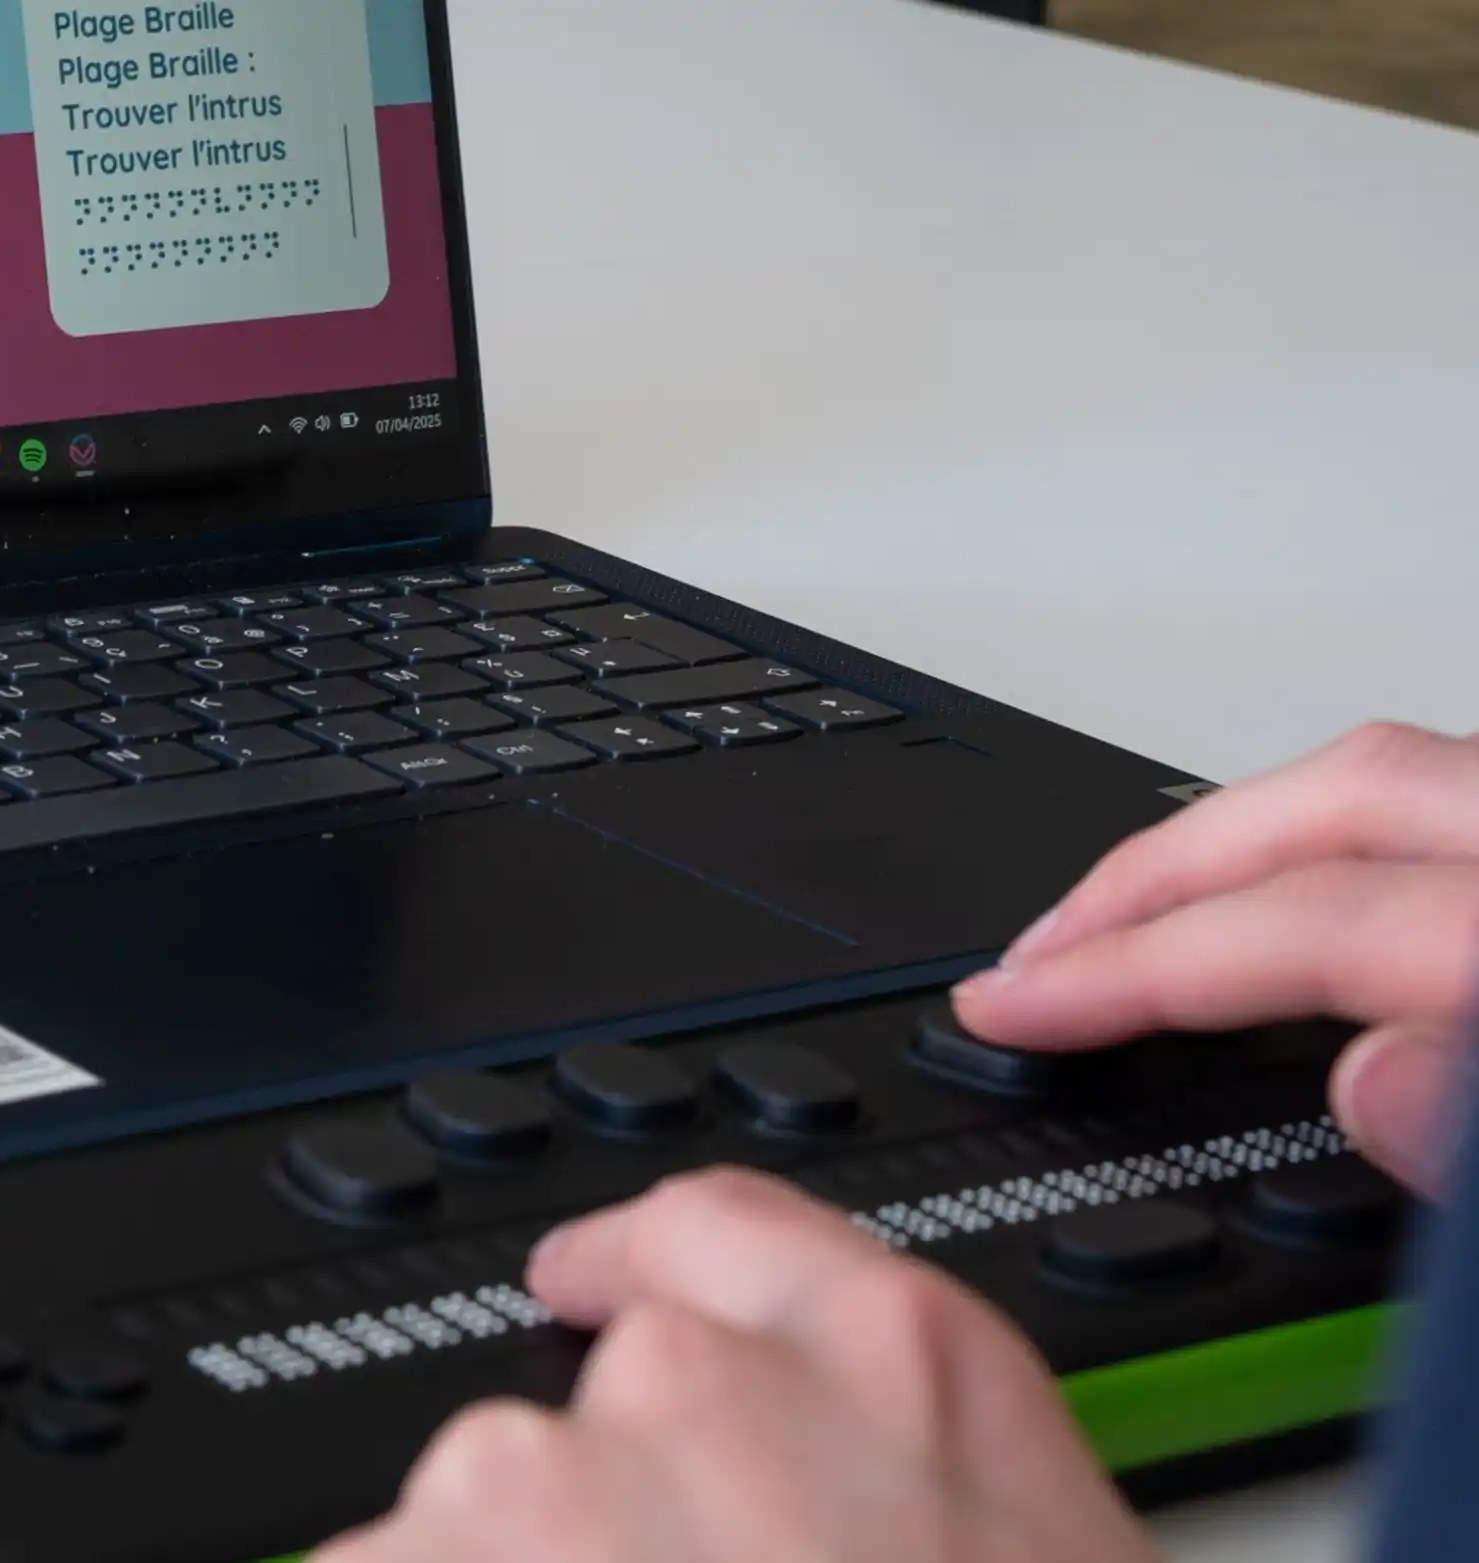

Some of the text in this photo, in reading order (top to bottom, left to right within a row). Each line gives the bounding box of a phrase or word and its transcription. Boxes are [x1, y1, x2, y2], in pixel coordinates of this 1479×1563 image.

[54, 1, 235, 43] Plage Braille
[58, 56, 139, 89] Plage
[149, 47, 238, 79] Braille
[61, 93, 282, 131] Trouver l'intrus
[65, 139, 287, 177] Trouver l'intrus
[408, 392, 441, 410] 13:12
[375, 413, 443, 434] 07/04/2025
[286, 647, 308, 657] P
[384, 670, 419, 681] M
[288, 686, 317, 695] L
[190, 697, 222, 708] K
[107, 750, 140, 761] N
